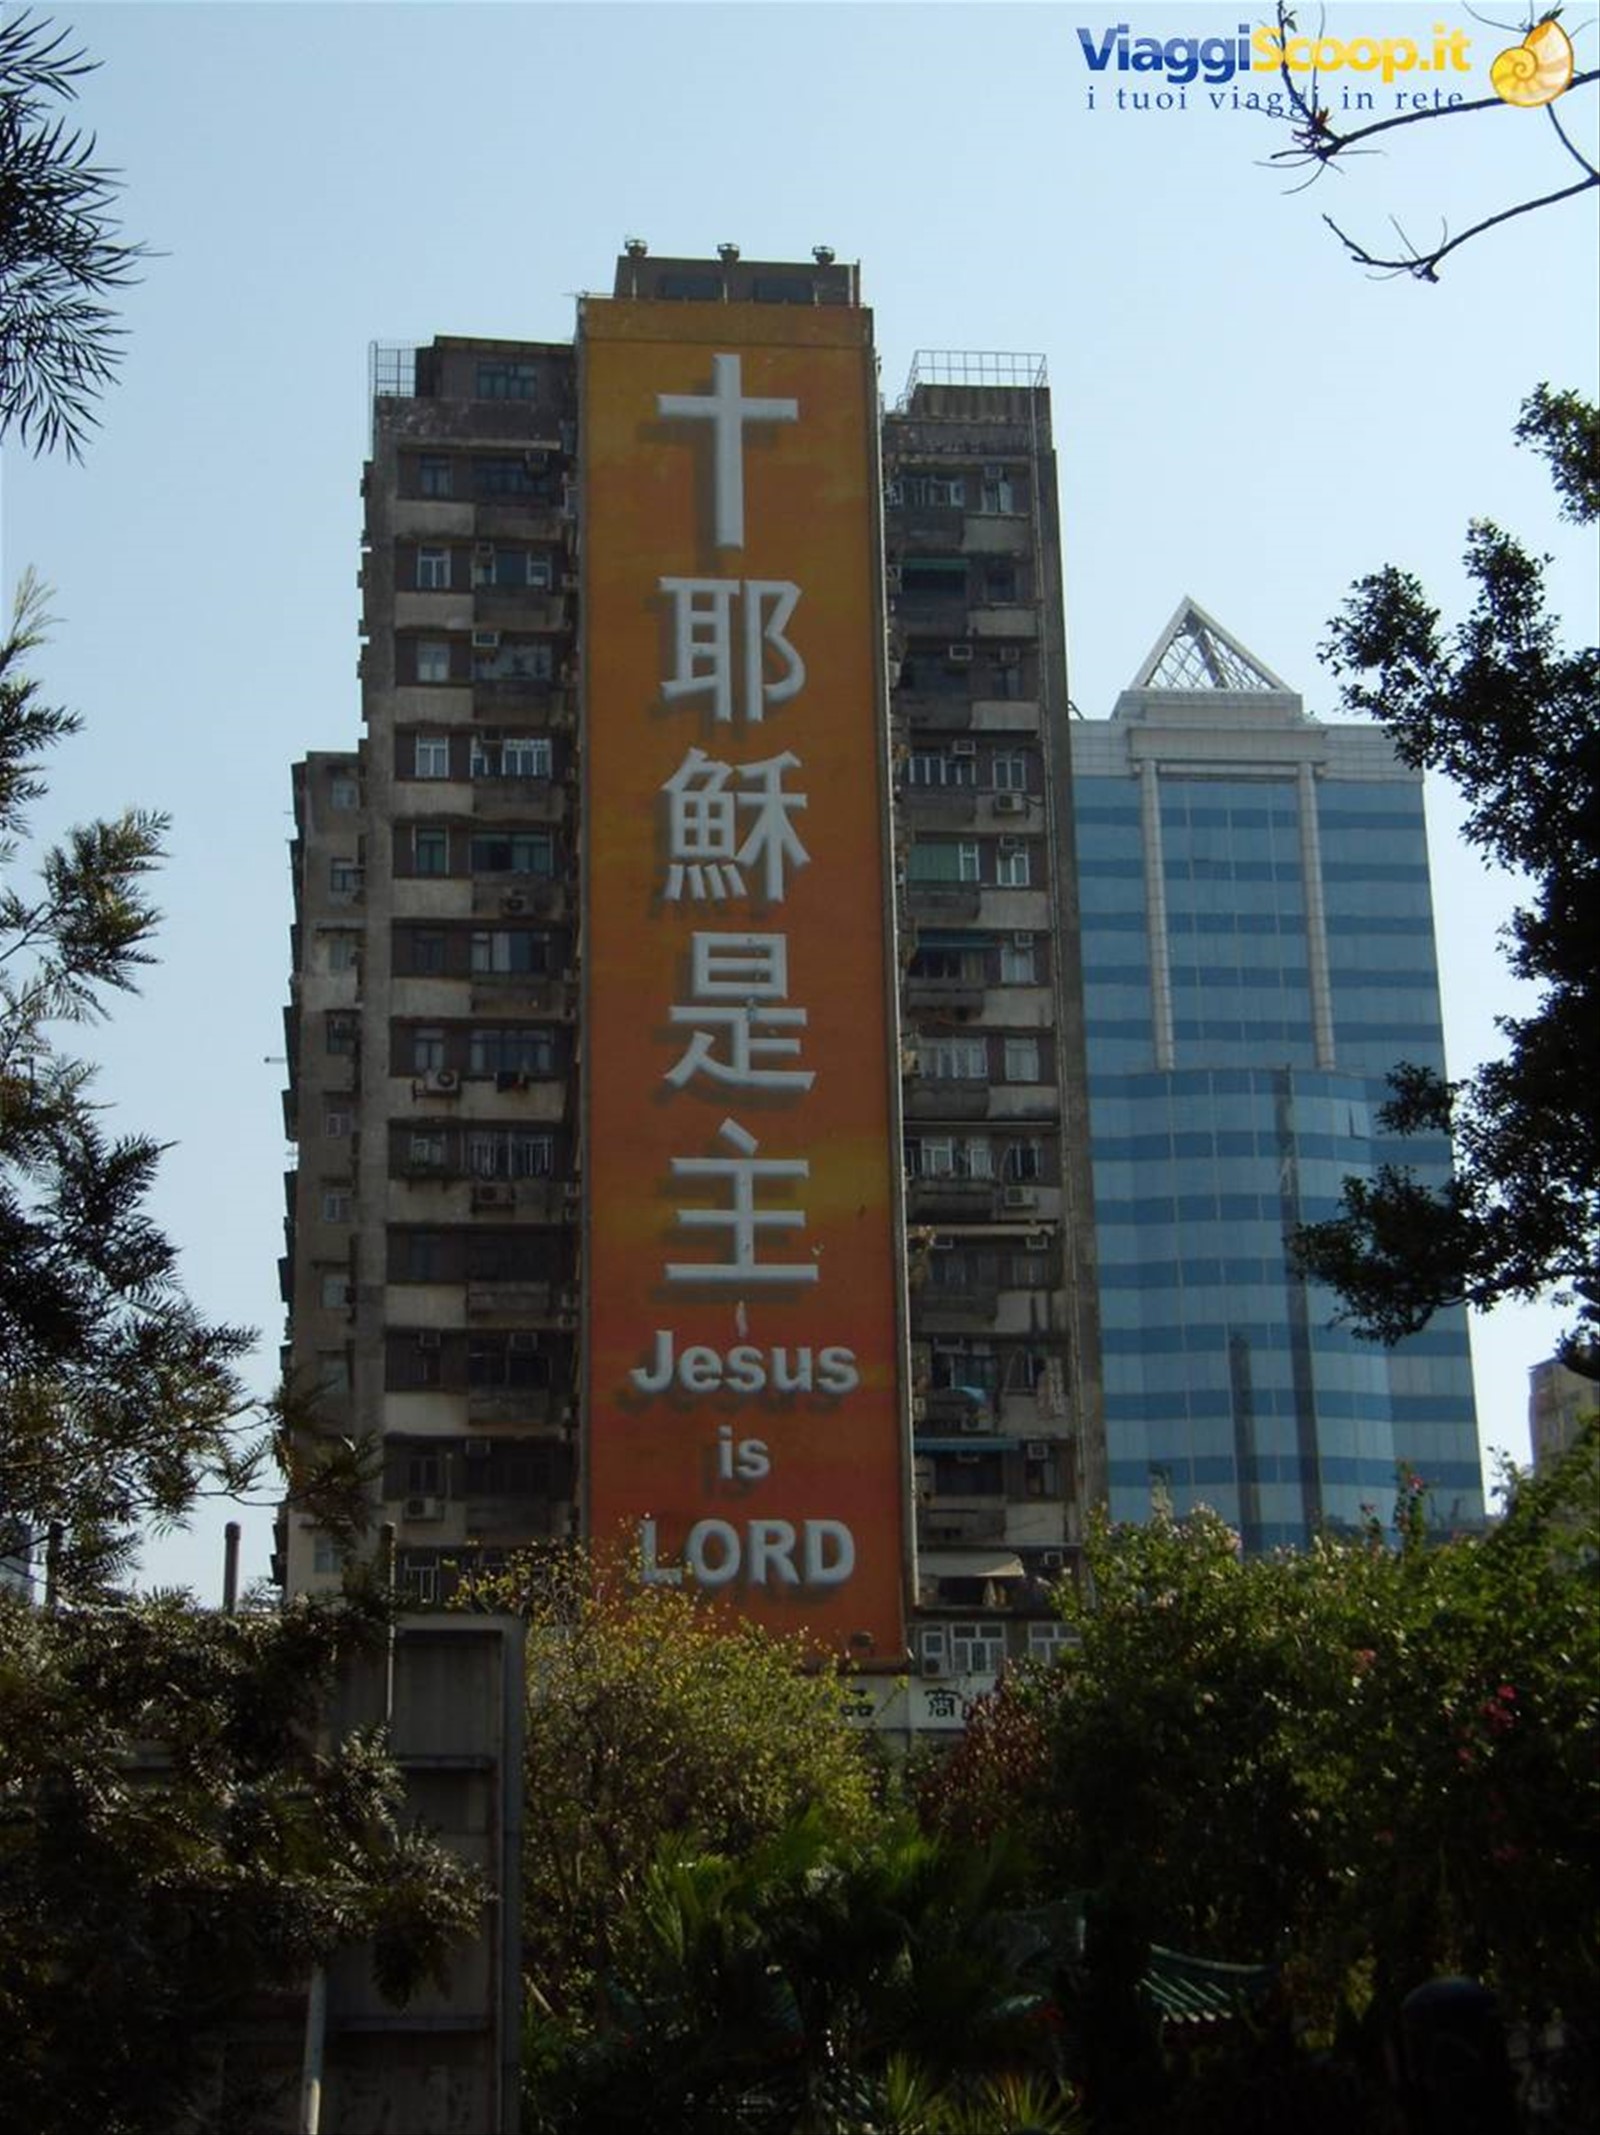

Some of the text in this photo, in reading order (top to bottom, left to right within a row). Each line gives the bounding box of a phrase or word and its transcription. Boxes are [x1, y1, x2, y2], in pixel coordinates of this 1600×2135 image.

[658, 577, 819, 1284] 耶穌是主
[630, 1330, 860, 1394] Jesus
[718, 1425, 771, 1479] is
[638, 1517, 856, 1588] LORD
